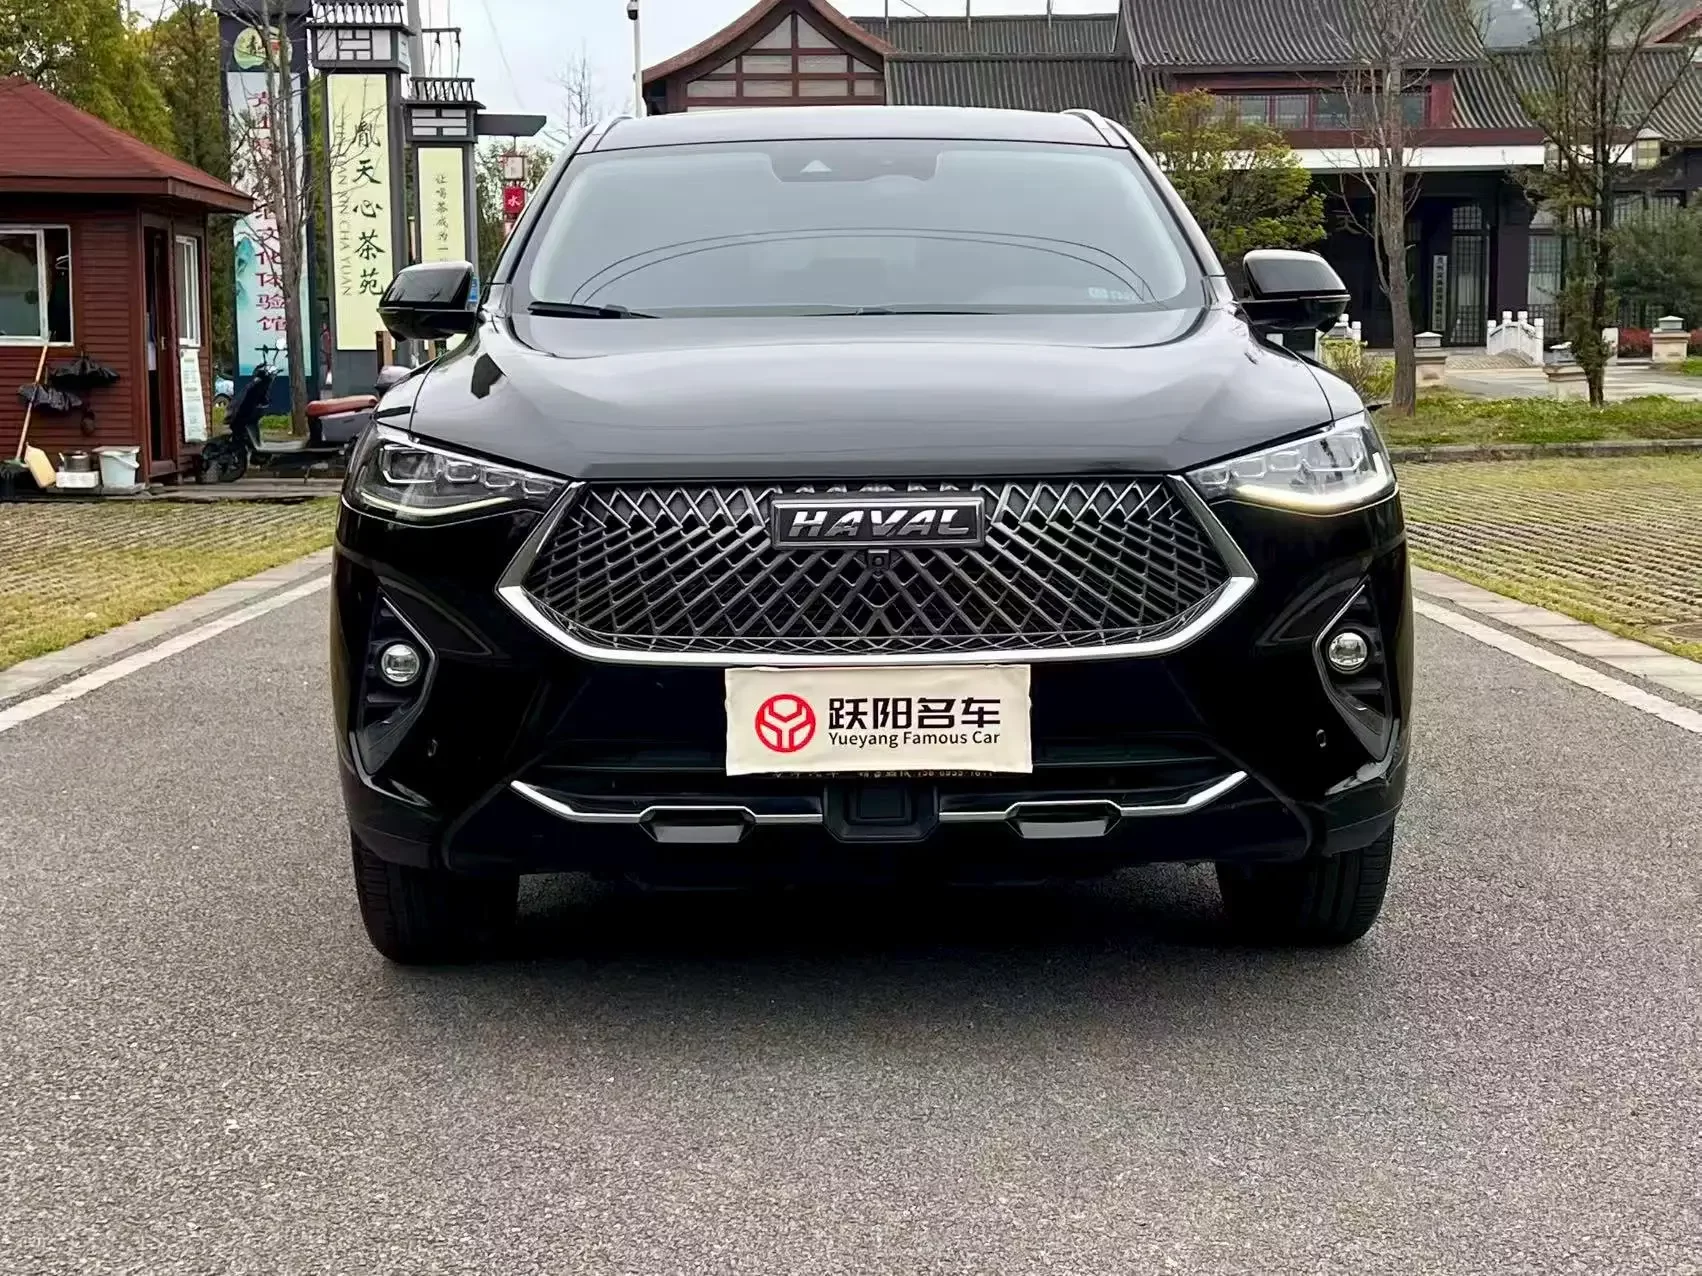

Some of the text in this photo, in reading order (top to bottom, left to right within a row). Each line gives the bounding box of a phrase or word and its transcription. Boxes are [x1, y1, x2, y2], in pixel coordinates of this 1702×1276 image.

[435, 173, 449, 261] 让喝茶成为一
[339, 220, 350, 251] CHA
[340, 256, 352, 296] YUAN
[788, 509, 969, 537] HAVAL
[828, 697, 1001, 730] 跃阳名车
[829, 731, 1000, 749] Yueyang Famous Car
